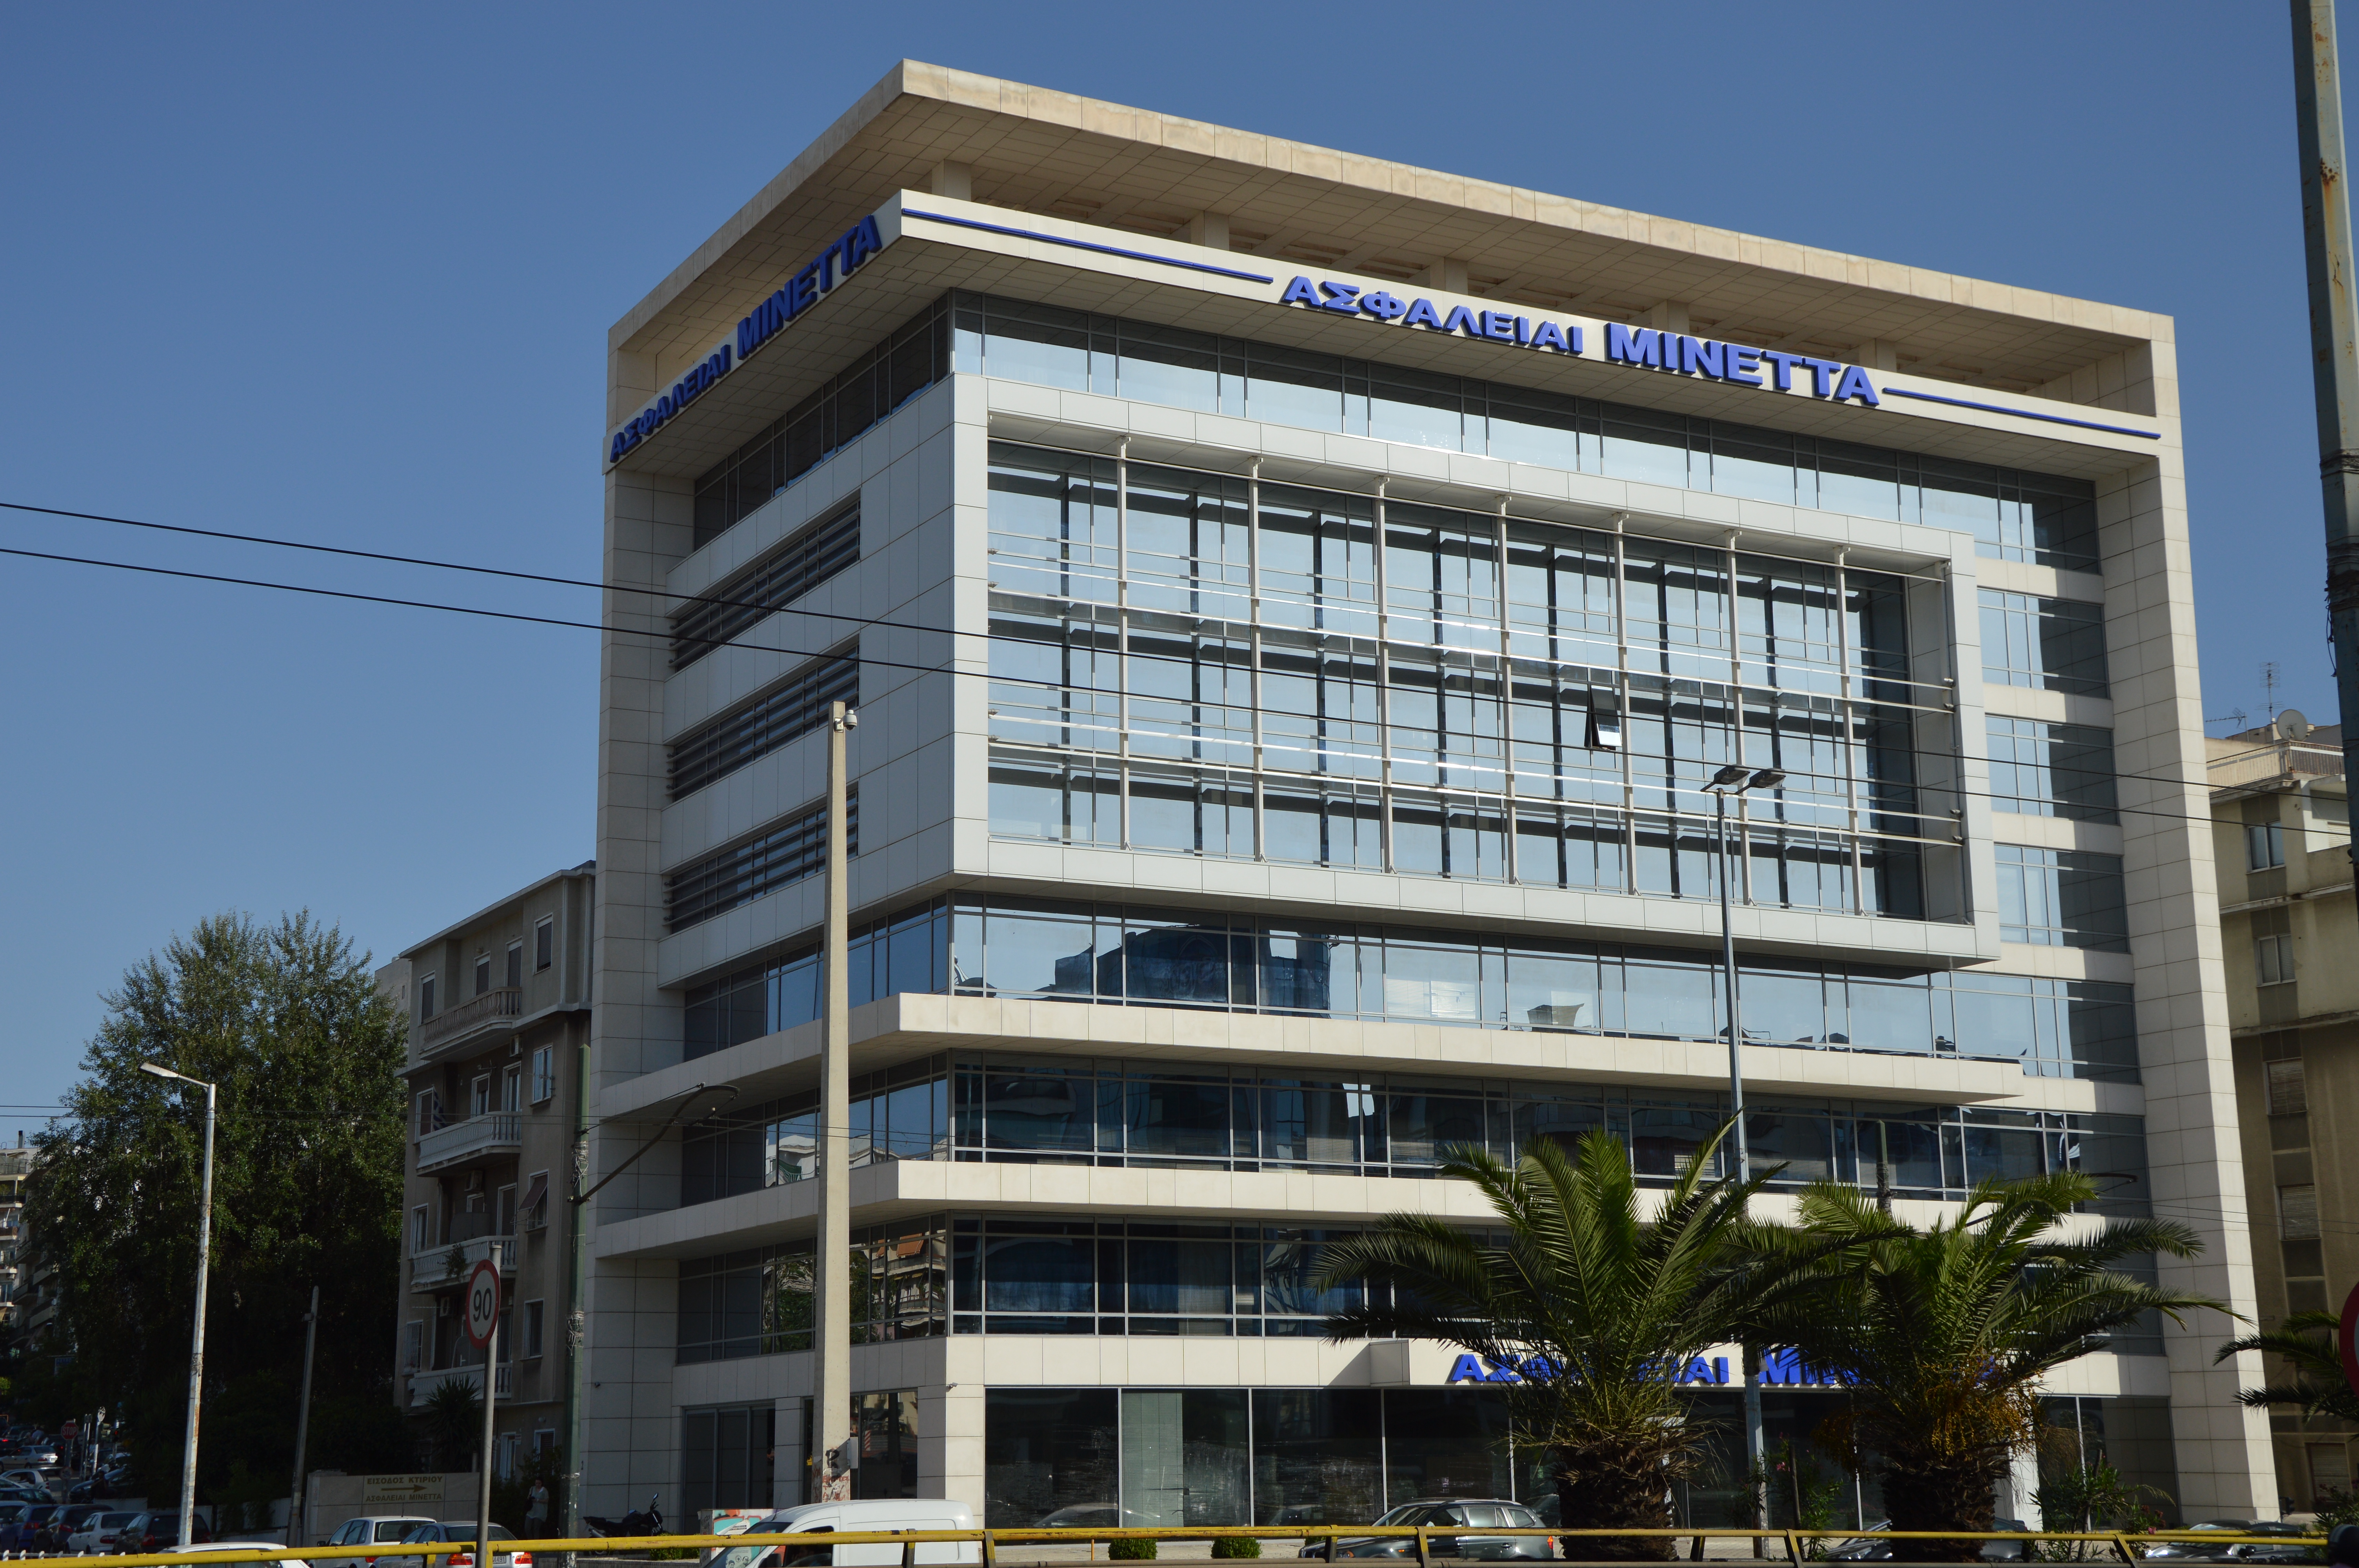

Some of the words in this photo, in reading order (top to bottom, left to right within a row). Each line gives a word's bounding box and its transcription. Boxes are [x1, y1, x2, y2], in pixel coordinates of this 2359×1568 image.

[610, 345, 731, 463] ΑΣΦΑΛΕΙΑΙ
[738, 214, 882, 360] ΜΙΝΕΤΤΑ
[1281, 276, 1583, 354] ΑΣΦΑΛΕΙΑΙ
[1607, 322, 1879, 406] ΜΙΝΕΤΤΑ
[473, 1287, 492, 1322] 90
[62, 1426, 77, 1436] STOP
